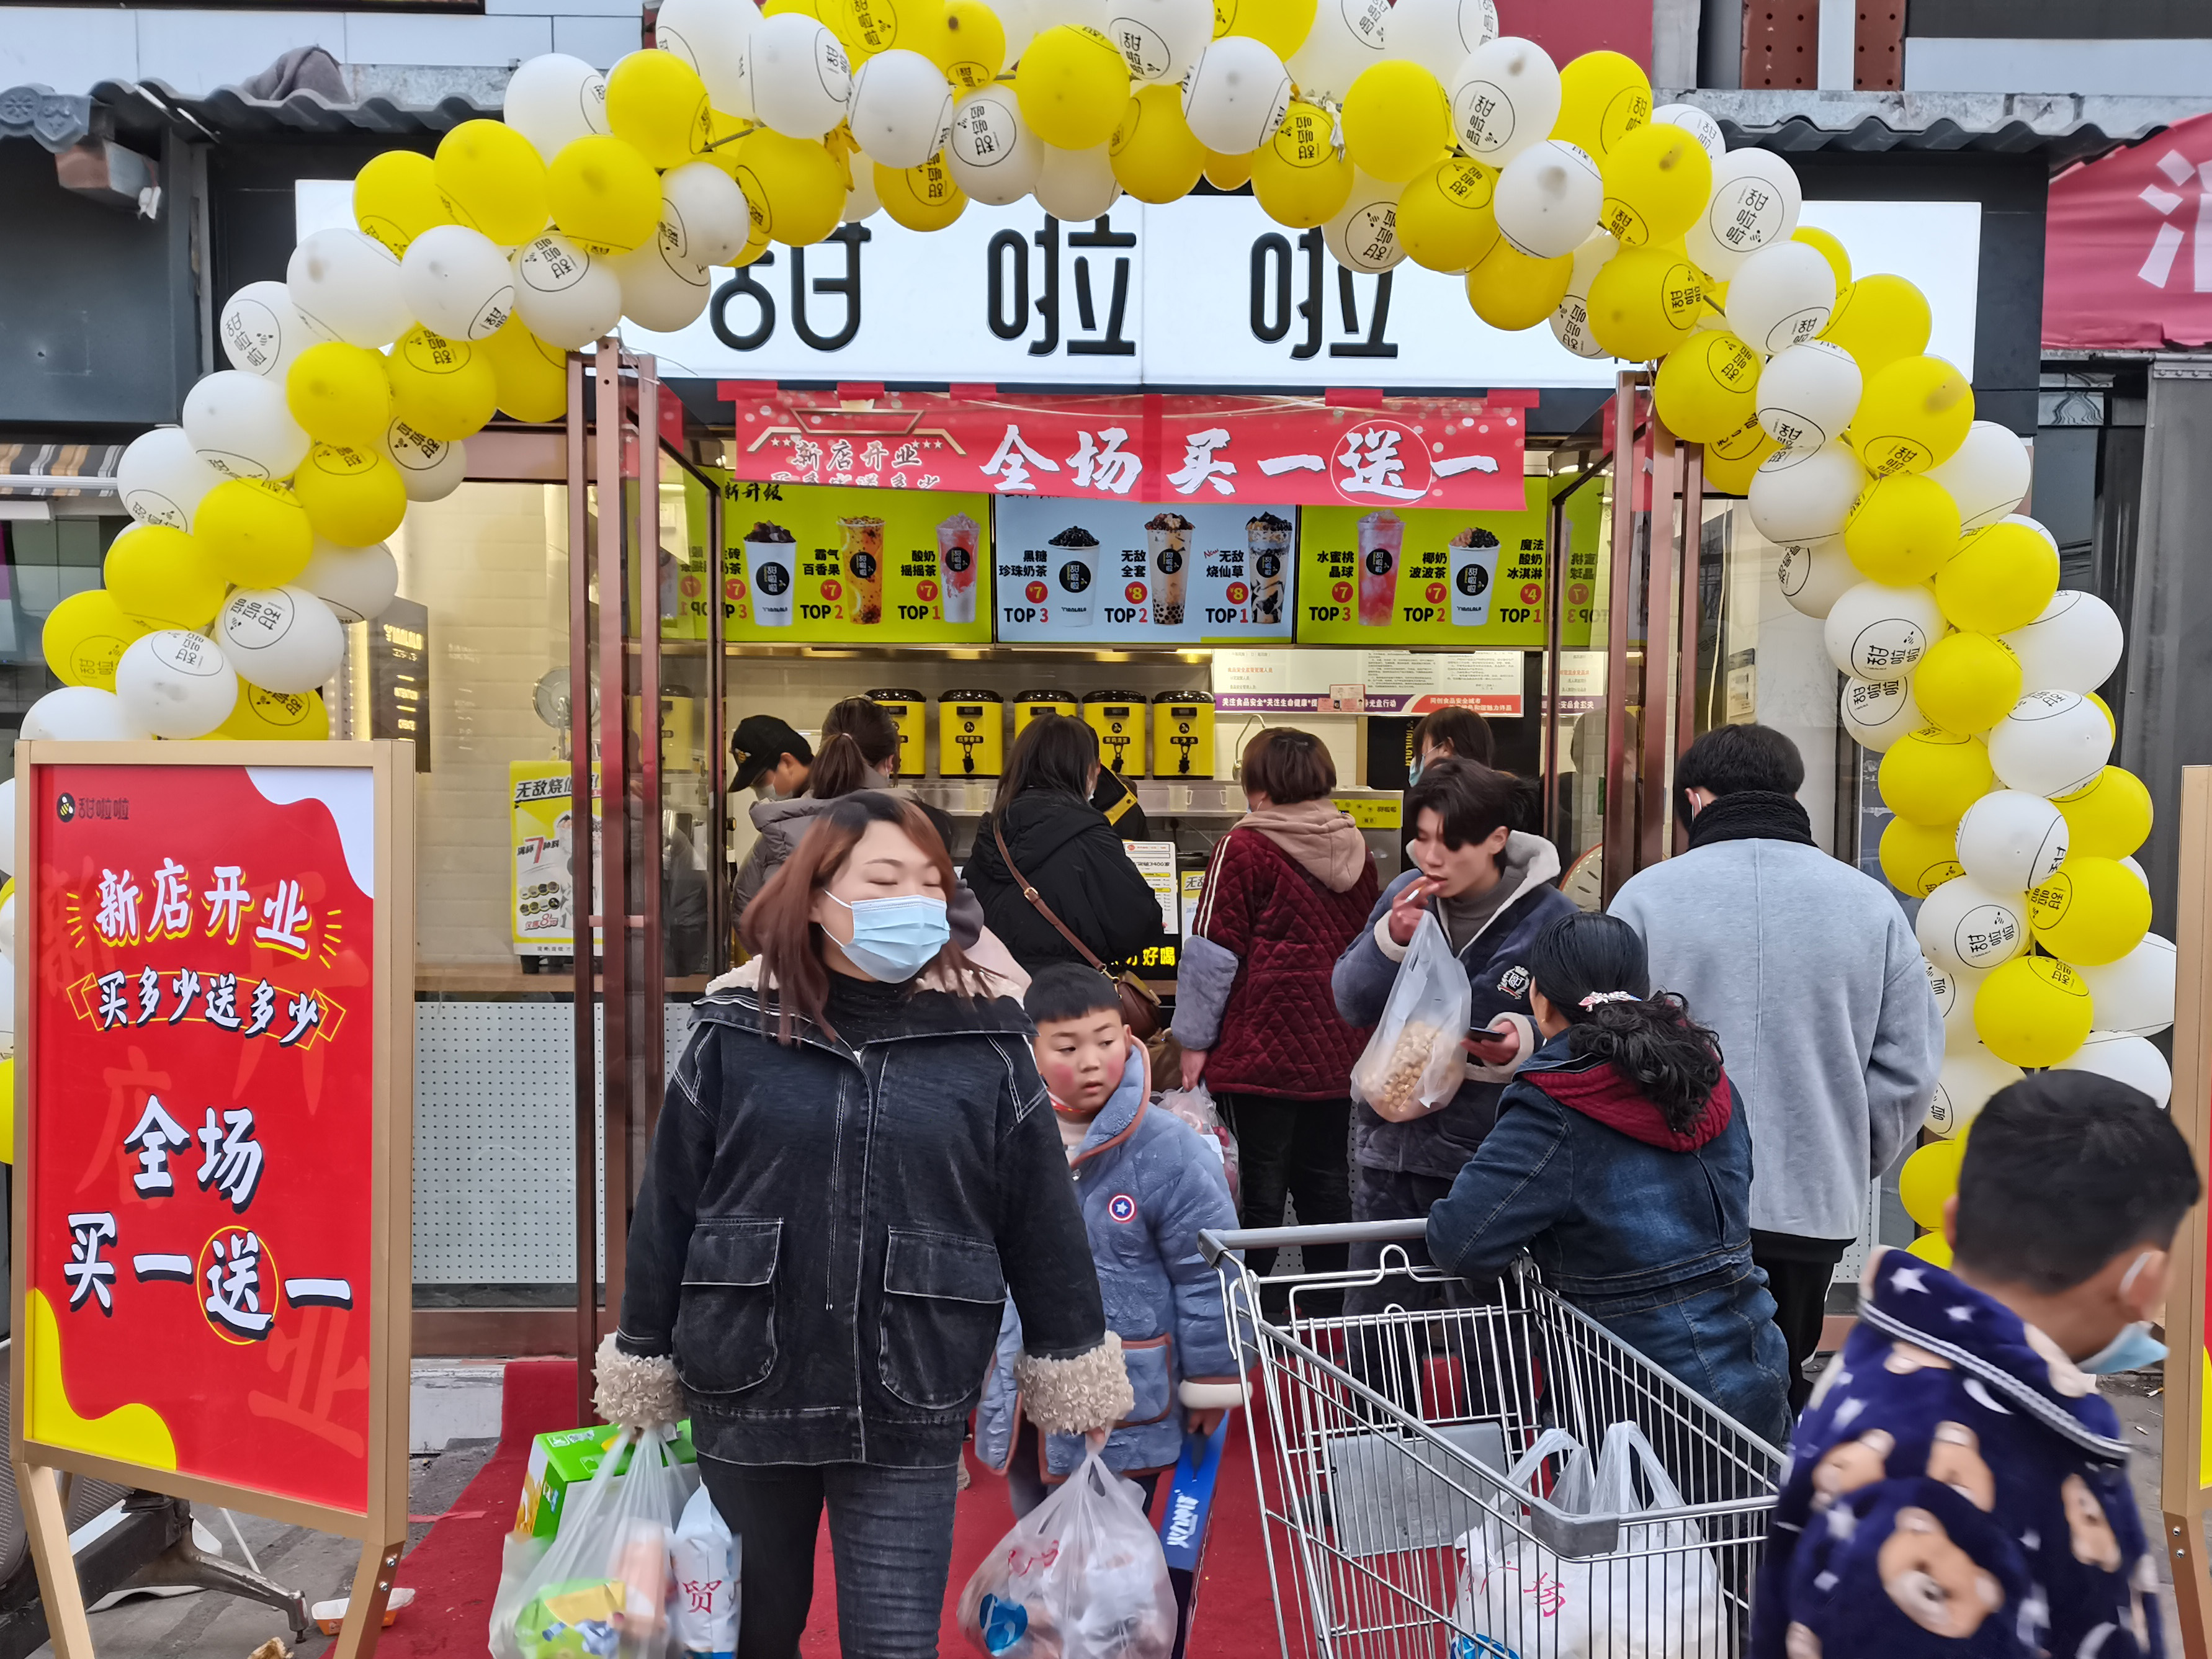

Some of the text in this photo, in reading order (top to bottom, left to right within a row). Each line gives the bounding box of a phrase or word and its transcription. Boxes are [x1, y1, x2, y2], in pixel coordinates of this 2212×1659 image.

[1466, 95, 1495, 146] 甜啦啦
[970, 105, 994, 156] 甜啦啦
[1296, 117, 1314, 159] 甜啦啦
[1449, 166, 1482, 197] 甜啦啦
[1726, 189, 1769, 244] 甜啦啦
[1670, 287, 1701, 308] 甜啦啦
[225, 311, 267, 367] 甜啦啦
[1721, 345, 1752, 382] 甜啦啦
[790, 439, 922, 471] 新店开业
[980, 424, 1498, 499] 全场买一送一
[1520, 539, 1544, 551] 魔法
[815, 548, 840, 561] 霸气
[911, 550, 935, 561] 酸奶
[1023, 550, 1047, 562] 黑糖
[1121, 550, 1146, 562] 无敌
[1219, 550, 1243, 562] 无敌
[1317, 551, 1355, 563] 水蜜桃
[1422, 552, 1447, 564] 椰奶
[1519, 553, 1543, 565] 酸奶
[803, 564, 840, 576] 百香果
[900, 564, 936, 576] 摇摇茶
[998, 565, 1047, 577] 珍珠奶茶
[1121, 565, 1146, 578] 全套
[1206, 565, 1243, 578] 烧仙草
[1329, 566, 1354, 578] 晶球
[1410, 567, 1446, 579] 波波茶
[1507, 568, 1543, 579] 冰淇淋
[231, 599, 281, 630] 甜啦啦
[739, 604, 747, 619] 3
[800, 605, 843, 619] TOP 2
[898, 606, 941, 620] TOP 1
[1004, 607, 1049, 622] TOP 3
[1104, 608, 1148, 622] TOP 2
[1206, 608, 1248, 623] TOP 1
[1309, 607, 1351, 621] TOP 3
[1404, 608, 1446, 622] TOP 2
[1500, 609, 1541, 623] TOP 1
[1867, 645, 1920, 665] 甜啦啦
[1854, 679, 1899, 705] 甜啦啦
[78, 797, 129, 820] 甜啦啦
[2030, 888, 2063, 910] 甜啦啦
[94, 857, 311, 957] 新店开业
[1969, 925, 2015, 953] 甜啦啦
[97, 965, 320, 1047] 买多少送多少
[124, 1094, 264, 1214] 全场
[64, 1212, 354, 1341] 买一送一
